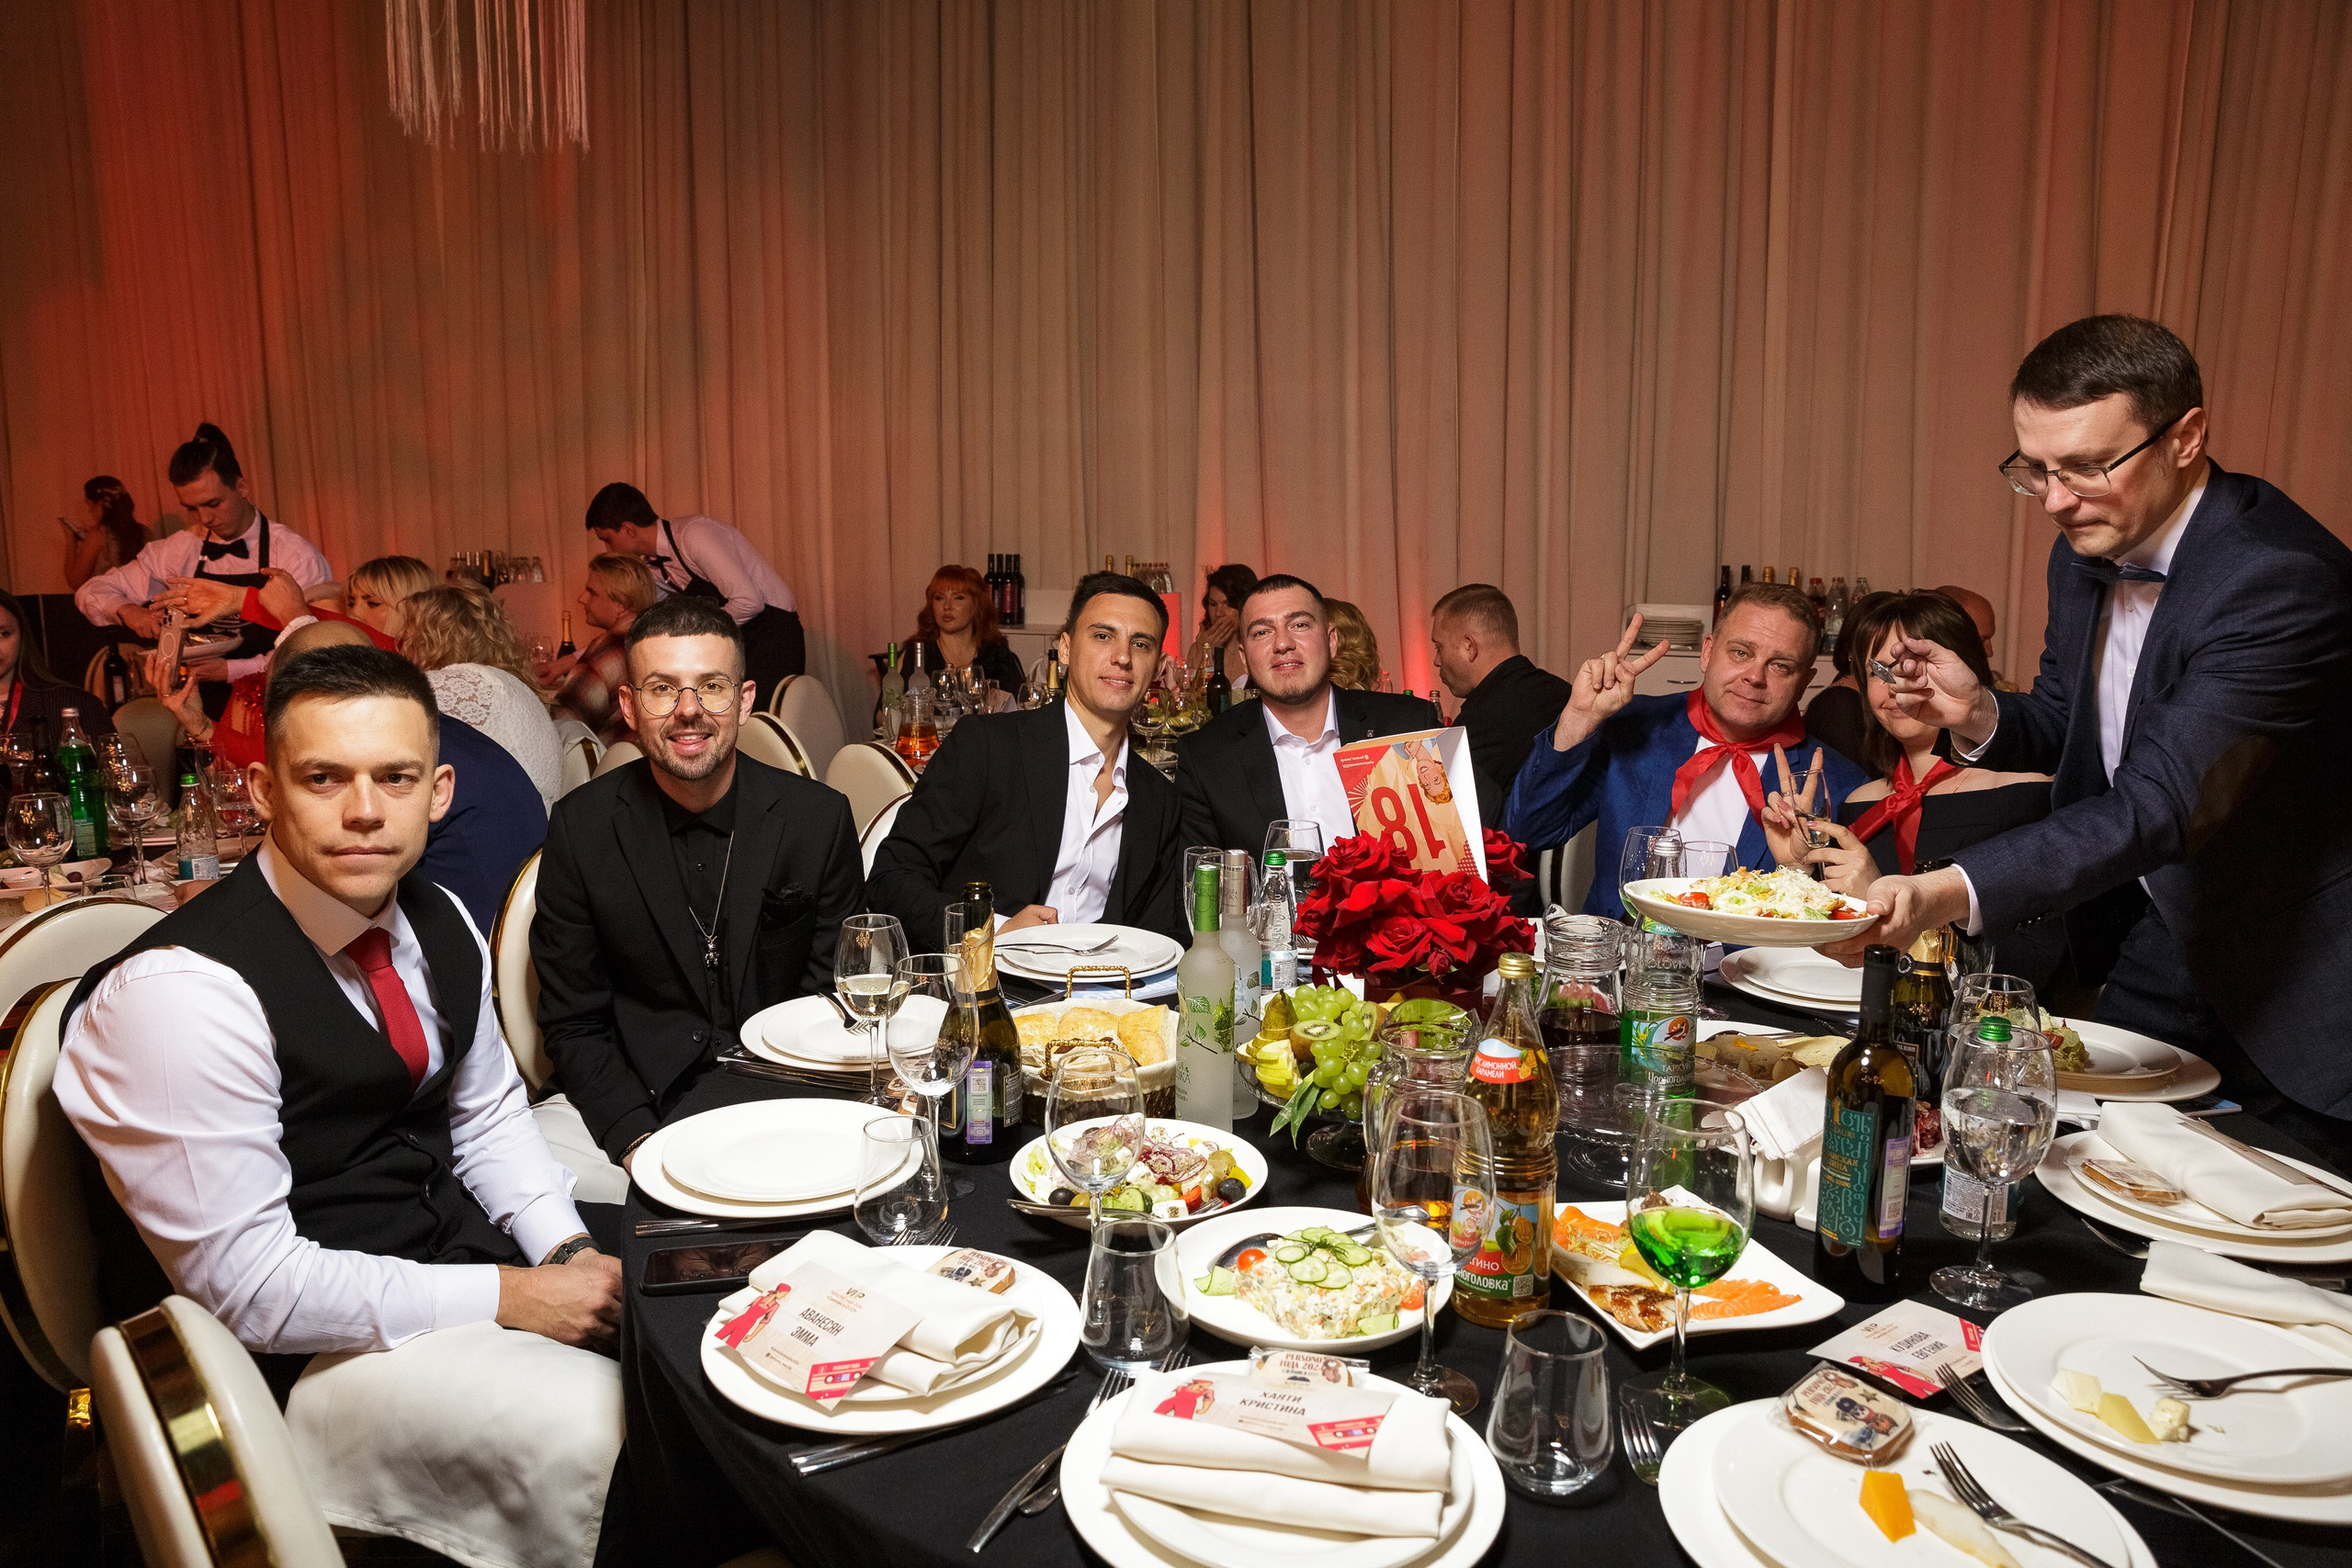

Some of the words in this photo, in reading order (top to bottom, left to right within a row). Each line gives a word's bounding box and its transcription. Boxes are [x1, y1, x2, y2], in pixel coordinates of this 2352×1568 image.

[1371, 784, 1446, 862] 18
[1476, 1066, 1505, 1078] КАРАМЕЛИ
[1482, 1060, 1517, 1071] ЛИМОННОЙ
[846, 1287, 865, 1299] VIP
[798, 1307, 844, 1337] АВАНЕСЯН
[790, 1325, 819, 1348] ЭММА
[1888, 1331, 1932, 1353] КУДИНОВА
[1285, 1353, 1322, 1363] PERSONO
[1911, 1340, 1949, 1360] ЕВГЕНИЯ
[1261, 1391, 1302, 1403] ХАЯТИ
[1239, 1398, 1306, 1416] КРИСТИНА
